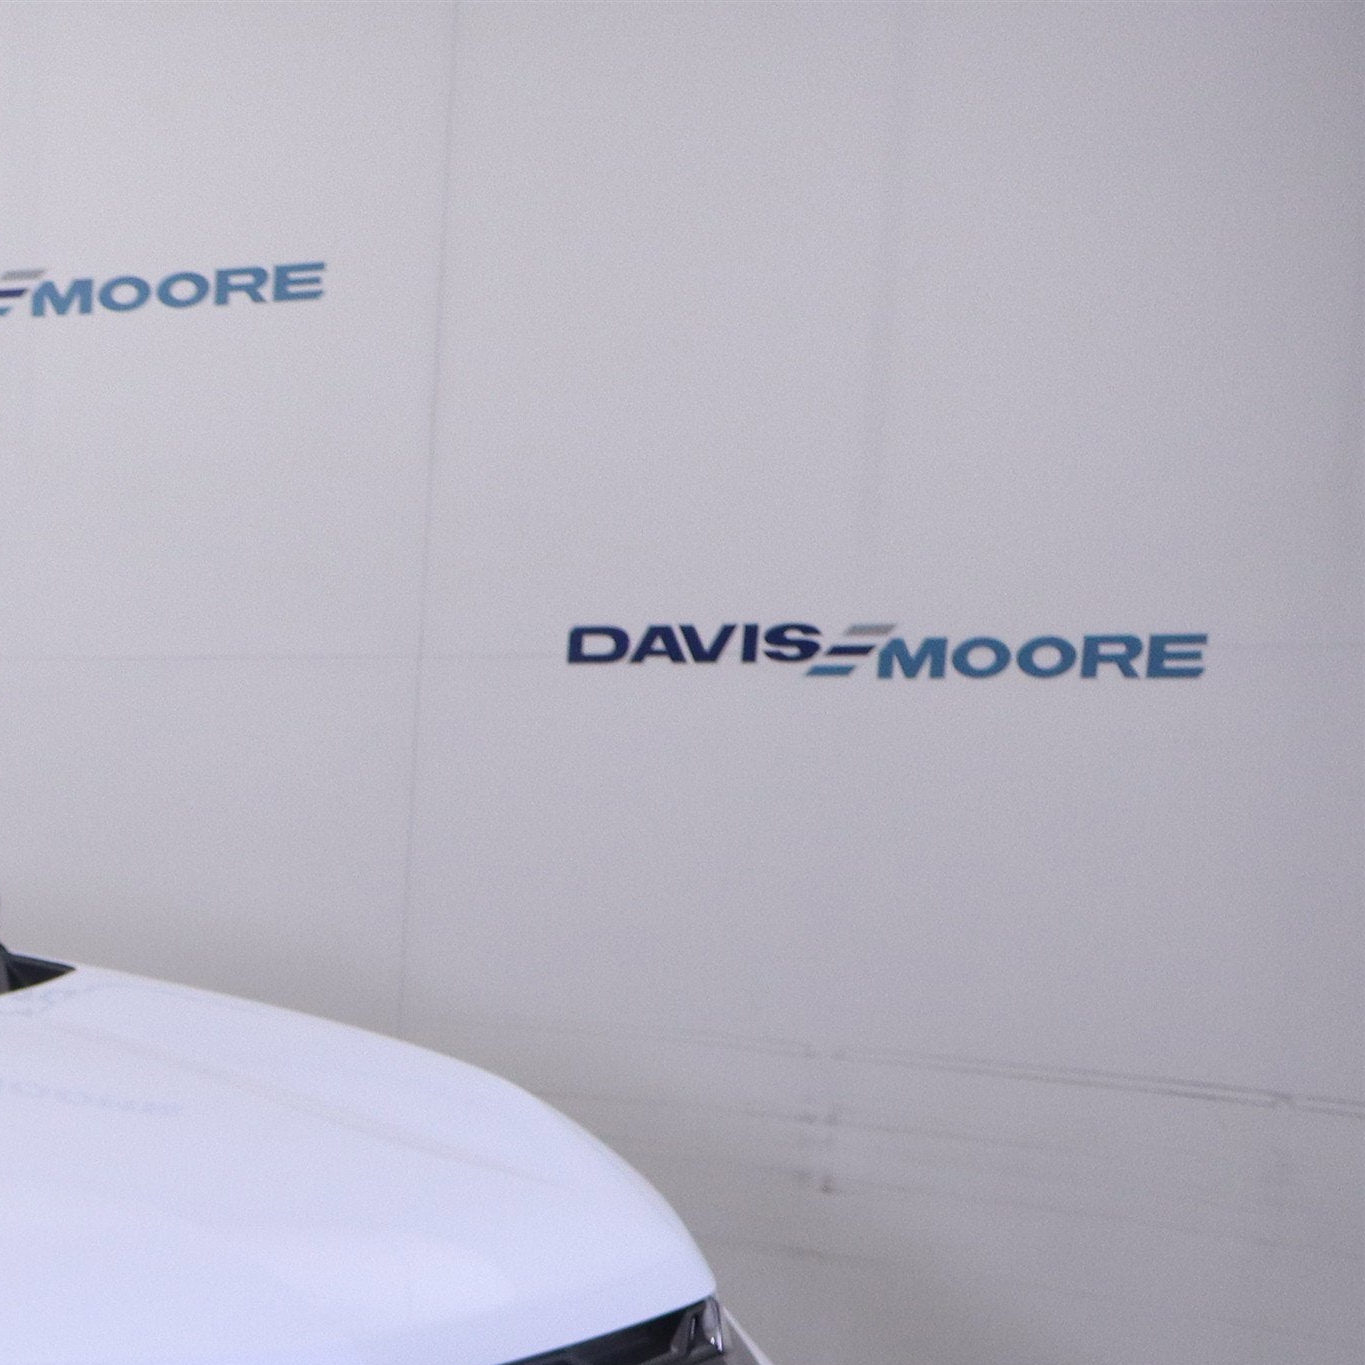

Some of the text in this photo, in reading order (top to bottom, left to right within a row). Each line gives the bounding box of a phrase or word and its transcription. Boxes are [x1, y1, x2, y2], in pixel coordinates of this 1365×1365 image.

[29, 260, 328, 319] MOORE
[565, 621, 1211, 681] DAVIS MOORE
